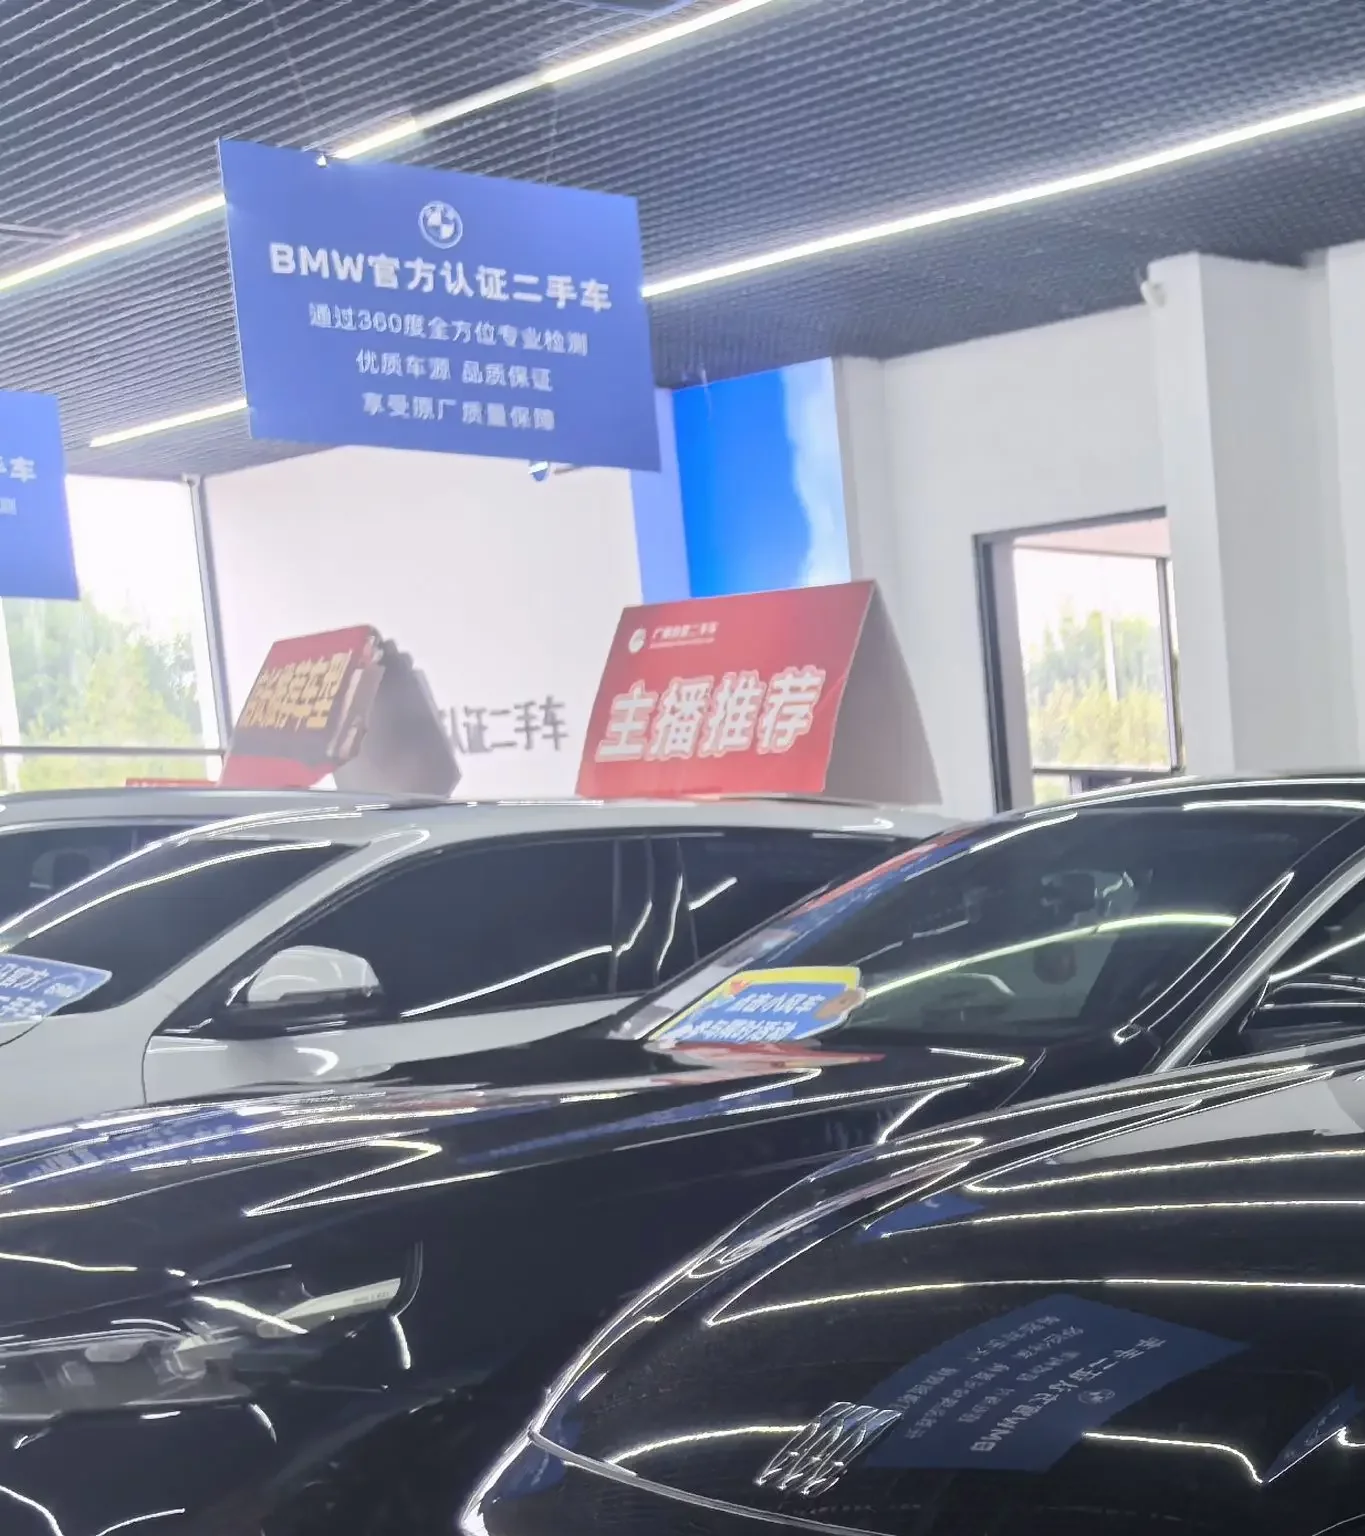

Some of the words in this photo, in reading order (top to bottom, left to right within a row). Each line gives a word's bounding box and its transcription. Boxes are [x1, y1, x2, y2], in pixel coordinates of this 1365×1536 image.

[269, 242, 612, 313] BMW官方认证二手车
[309, 302, 589, 357] 通过360度全方位专业检测
[356, 348, 451, 382] 优质车源
[461, 360, 553, 392] 品质保证
[0, 455, 37, 483] 车
[596, 666, 826, 762] 主播推荐
